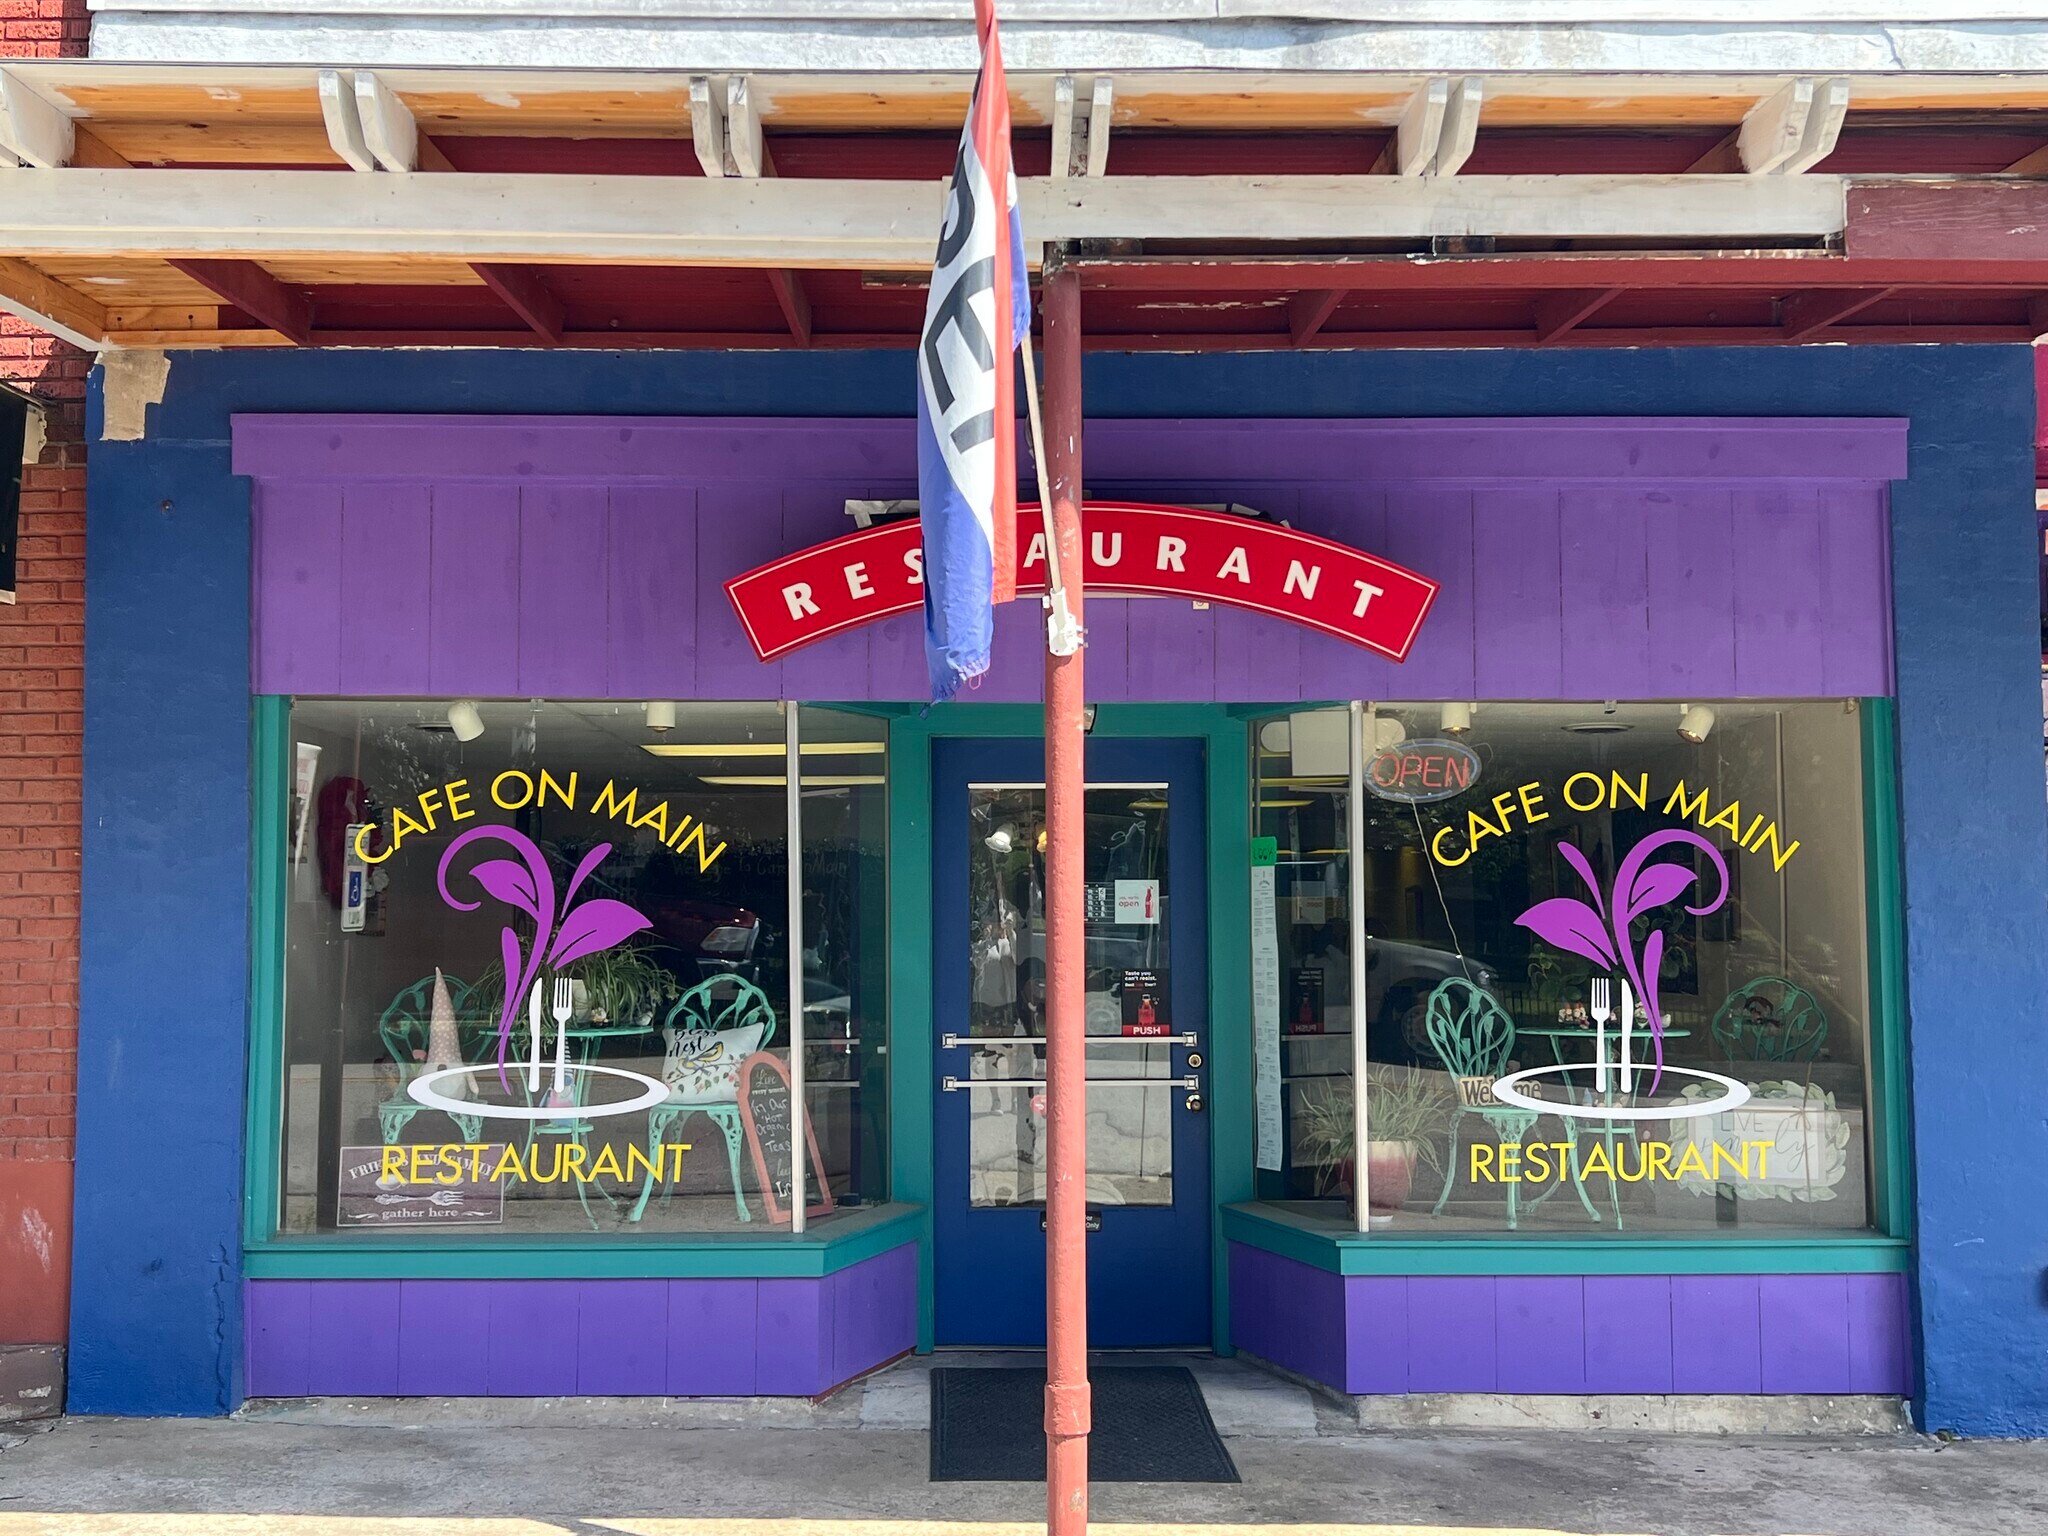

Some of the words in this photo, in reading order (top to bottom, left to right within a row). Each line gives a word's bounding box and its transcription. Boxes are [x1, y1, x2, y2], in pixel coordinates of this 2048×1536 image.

[782, 532, 1385, 621] RESAURANT
[1372, 752, 1470, 788] OPEN
[355, 779, 476, 864] CAFE
[491, 770, 578, 811] ON
[592, 782, 727, 873] MAIN
[1431, 783, 1549, 867] CAFE
[1563, 771, 1649, 812] ON
[1662, 782, 1801, 871] MAIN
[1132, 1026, 1162, 1035] PUSH
[382, 1144, 692, 1183] RESTAURANT
[765, 1140, 791, 1153] Teas
[1470, 1143, 1776, 1181] RESTAURANT
[381, 1207, 425, 1220] gather
[428, 1207, 459, 1218] here
